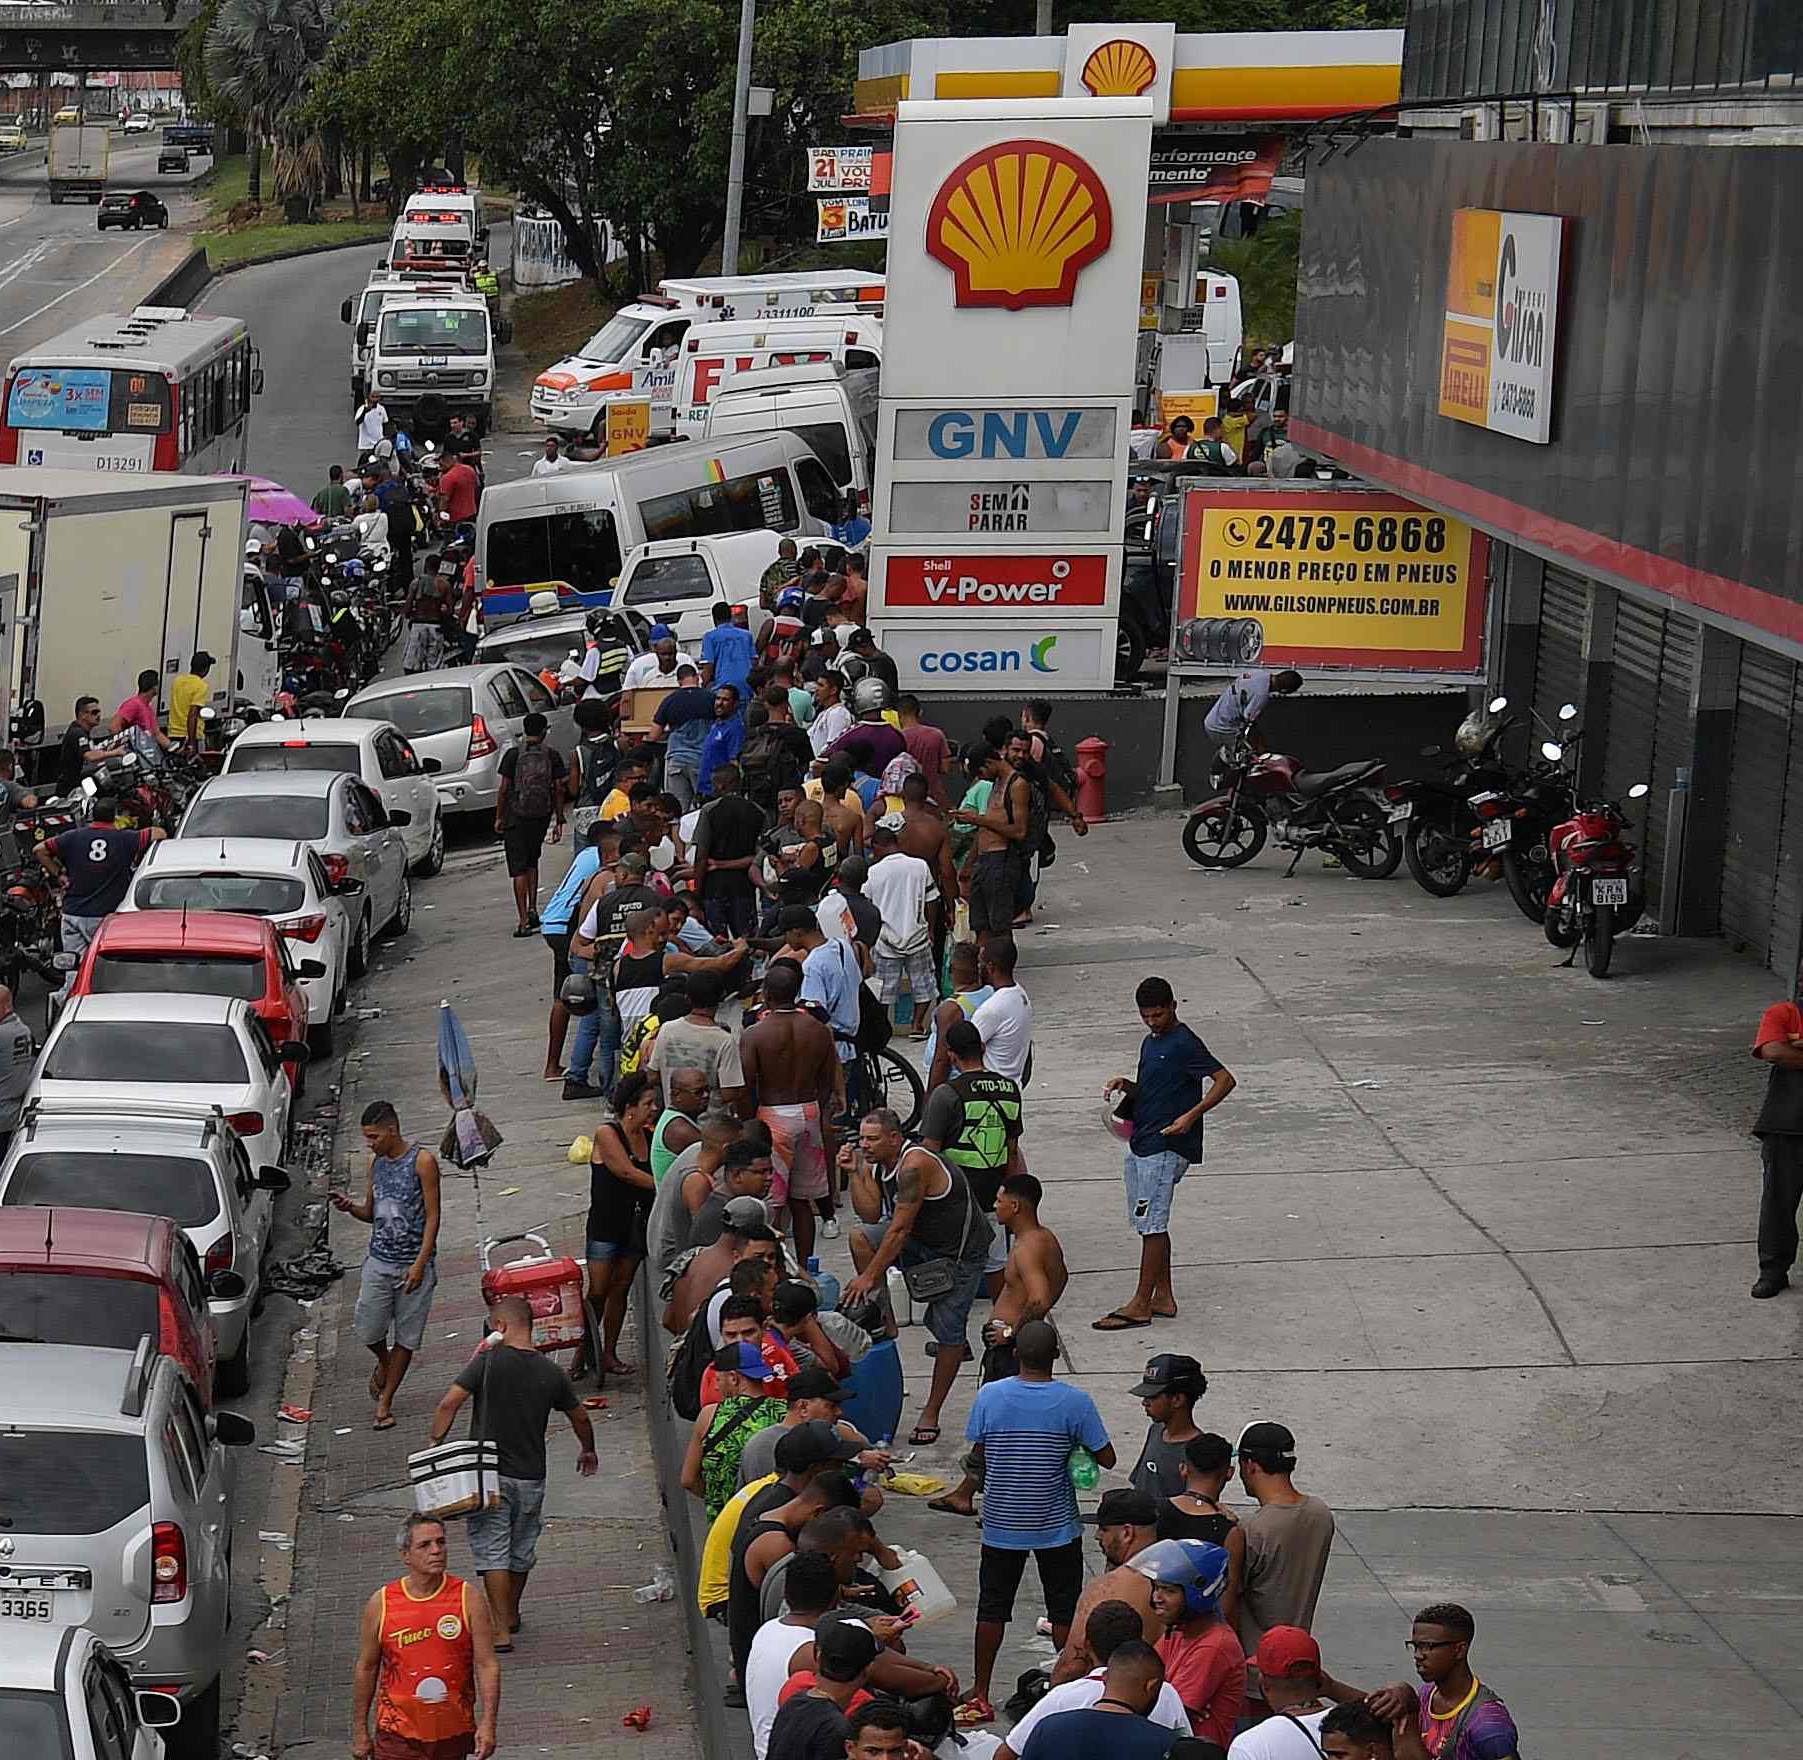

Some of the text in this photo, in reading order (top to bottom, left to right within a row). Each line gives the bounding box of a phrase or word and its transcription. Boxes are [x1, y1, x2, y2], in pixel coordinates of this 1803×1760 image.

[816, 158, 836, 178] 21
[611, 427, 646, 440] GNV
[928, 411, 1084, 460] GNV
[97, 456, 144, 472] D13291
[971, 493, 1008, 512] SEM
[969, 513, 1028, 531] PARAR
[1255, 514, 1446, 553] 2473-6868
[923, 560, 952, 571] Shell
[1210, 560, 1458, 585] O MENOR PREÇO EM PNEUS
[923, 576, 1063, 602] V-Power
[1224, 594, 1441, 616] WWW.GILSONPNEUS.COM.BR
[919, 649, 1021, 673] cosan
[89, 838, 108, 862] 8
